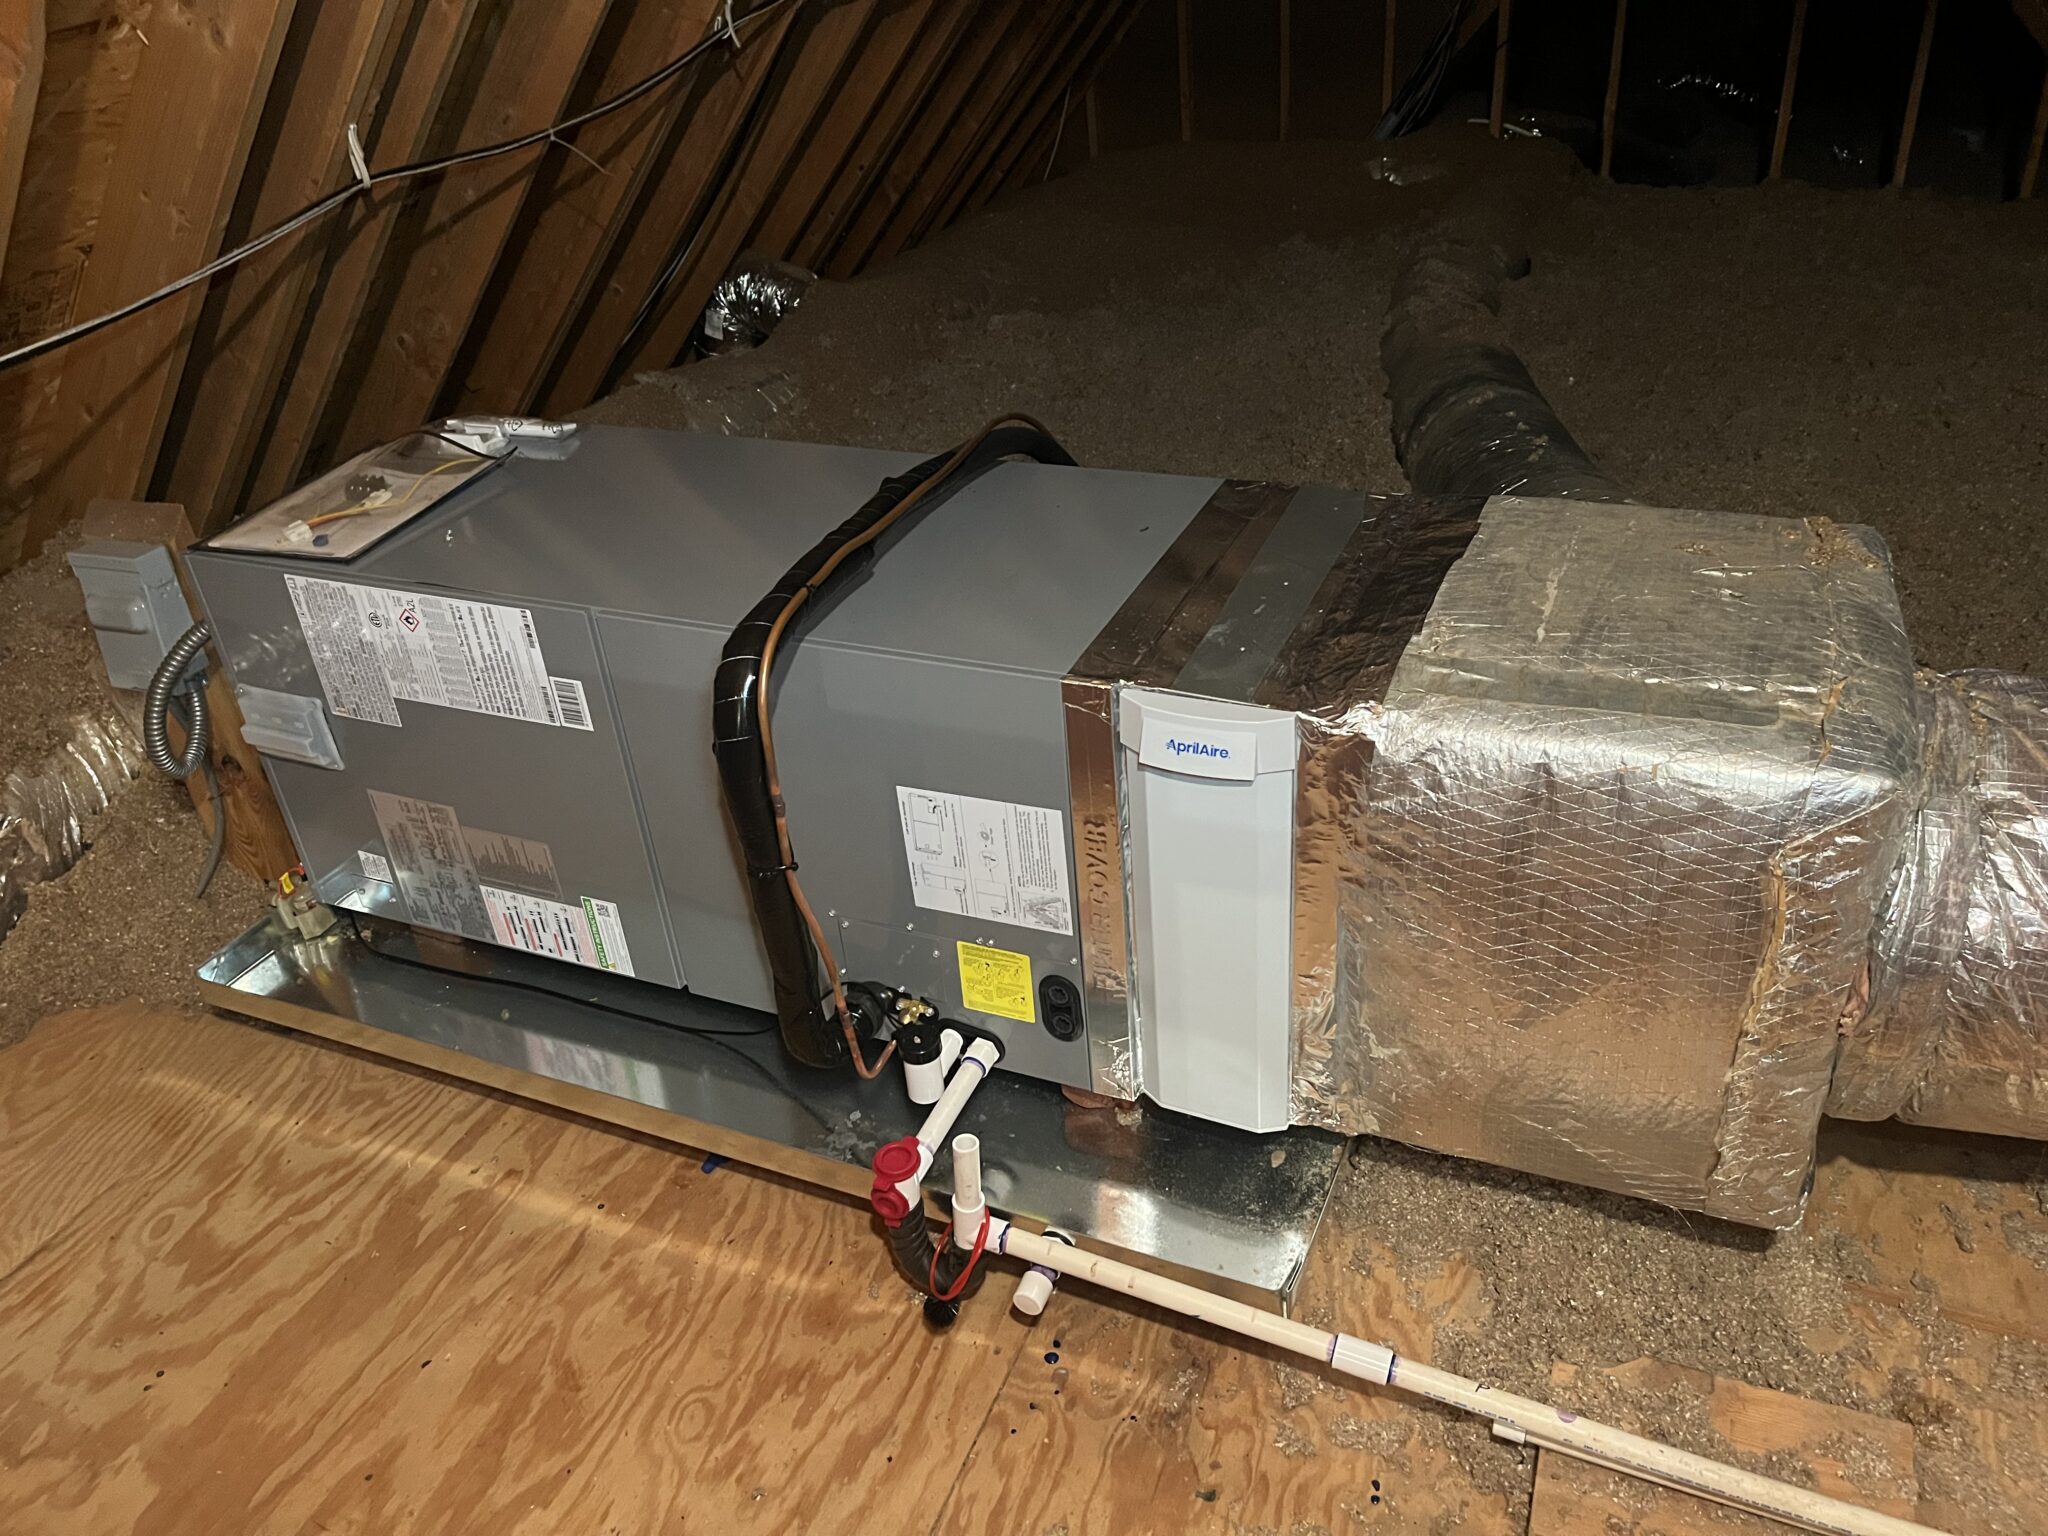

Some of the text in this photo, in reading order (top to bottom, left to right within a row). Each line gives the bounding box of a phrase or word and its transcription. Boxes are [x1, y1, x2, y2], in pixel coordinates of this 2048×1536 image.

[406, 599, 417, 614] A2L
[1166, 738, 1230, 759] AprilAire
[1083, 813, 1109, 906] COVER
[584, 900, 608, 967] SAFETY INSTRUCTIONS
